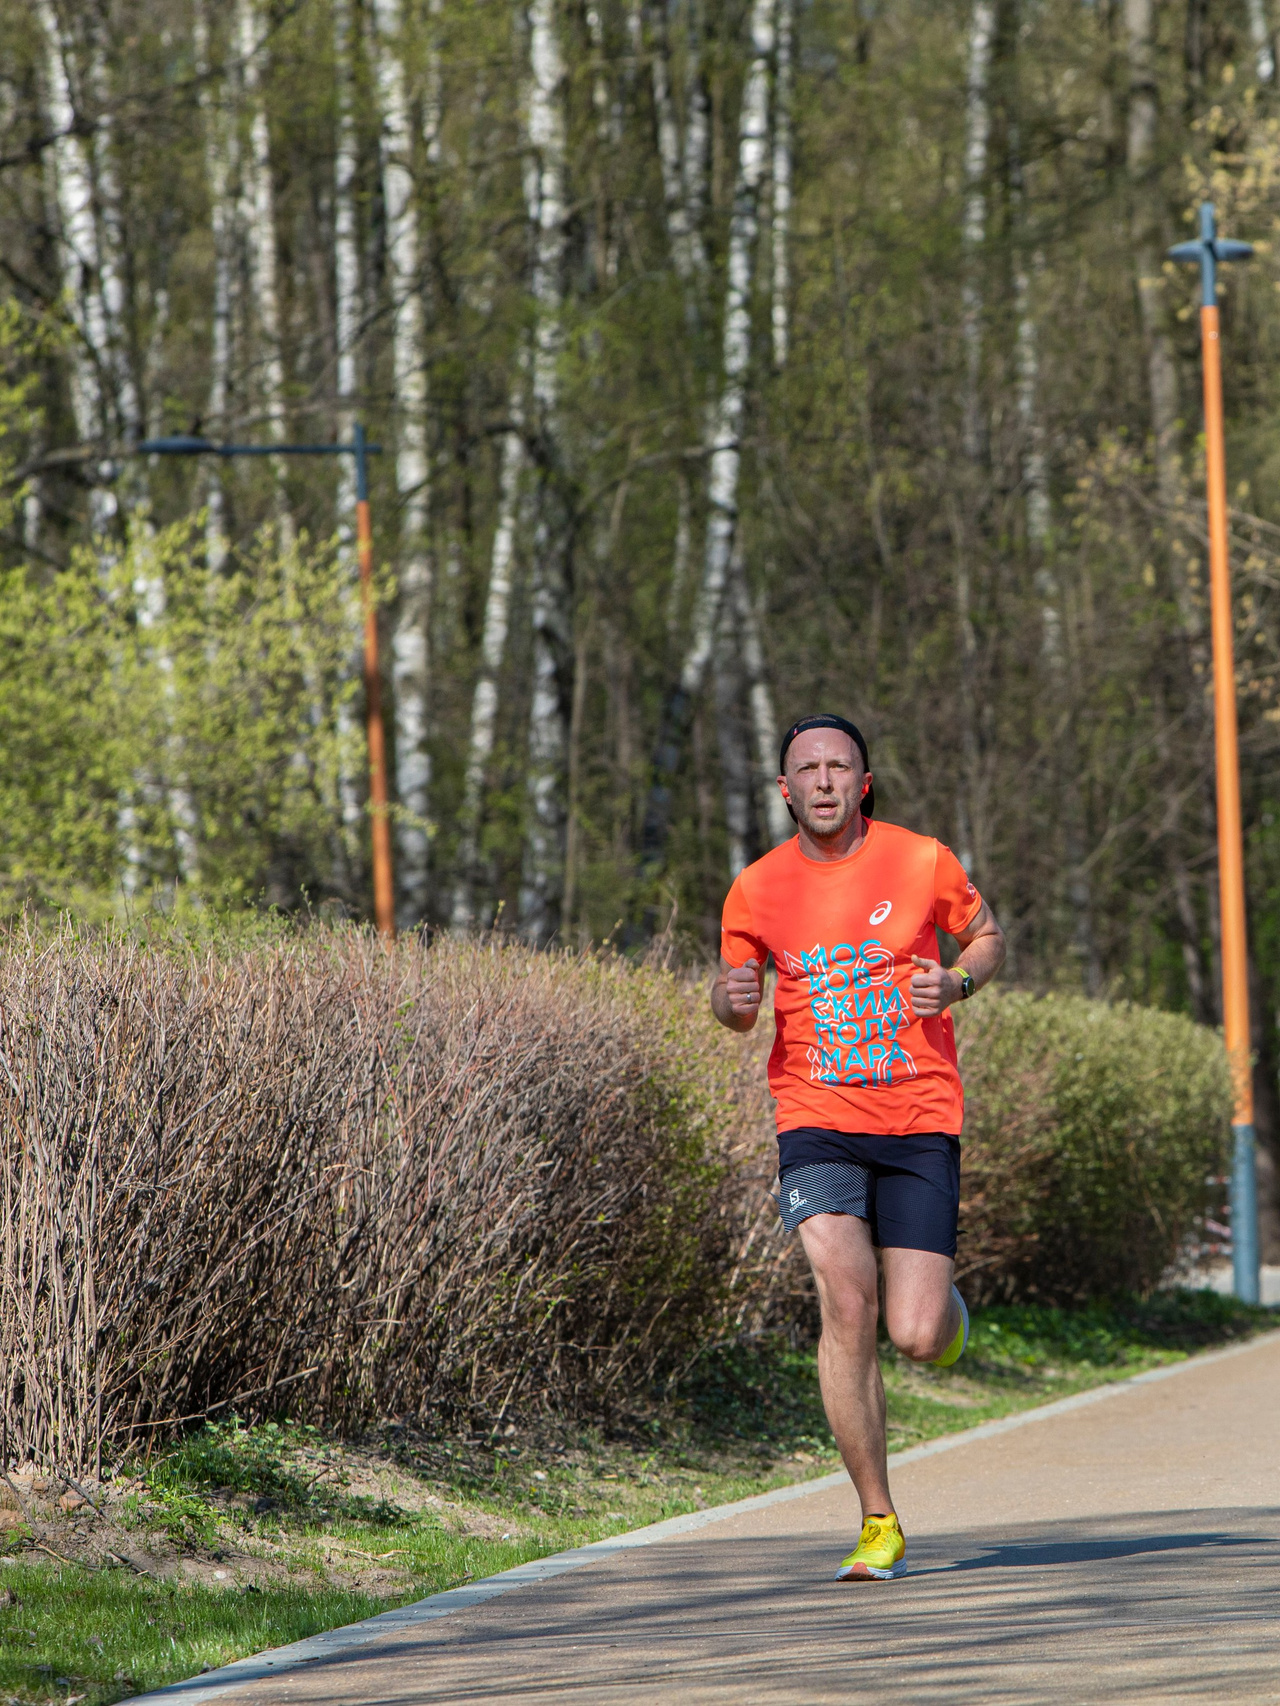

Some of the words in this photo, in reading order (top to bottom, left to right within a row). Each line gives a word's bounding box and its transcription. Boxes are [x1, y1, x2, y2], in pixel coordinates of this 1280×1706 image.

[800, 939, 883, 974] МОС
[808, 967, 872, 995] КОВ
[810, 981, 902, 1020] СКИЙ
[814, 1013, 903, 1045] ПОЛУ
[819, 1041, 908, 1072] МАРА
